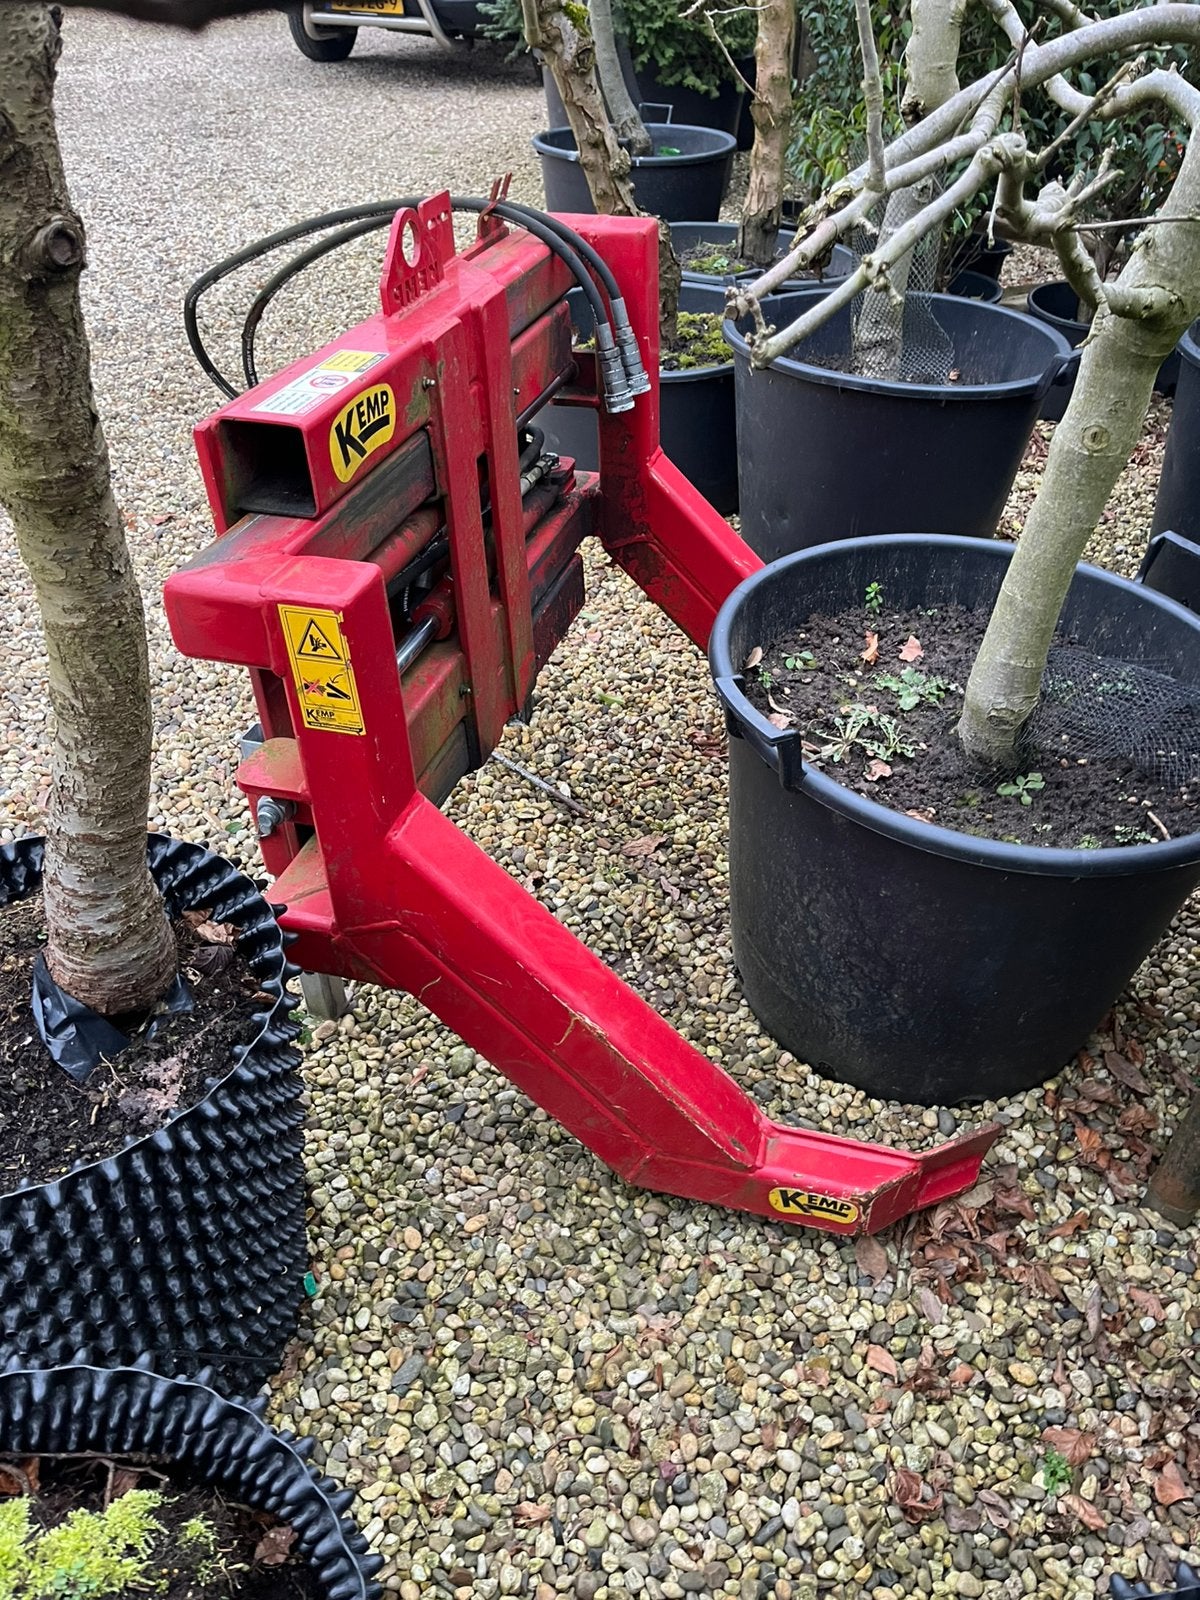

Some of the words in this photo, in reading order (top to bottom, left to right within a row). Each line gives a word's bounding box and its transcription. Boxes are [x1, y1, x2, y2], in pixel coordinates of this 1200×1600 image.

[334, 389, 389, 469] KEMP
[305, 708, 335, 722] KEMP
[779, 1189, 852, 1215] KEMP
